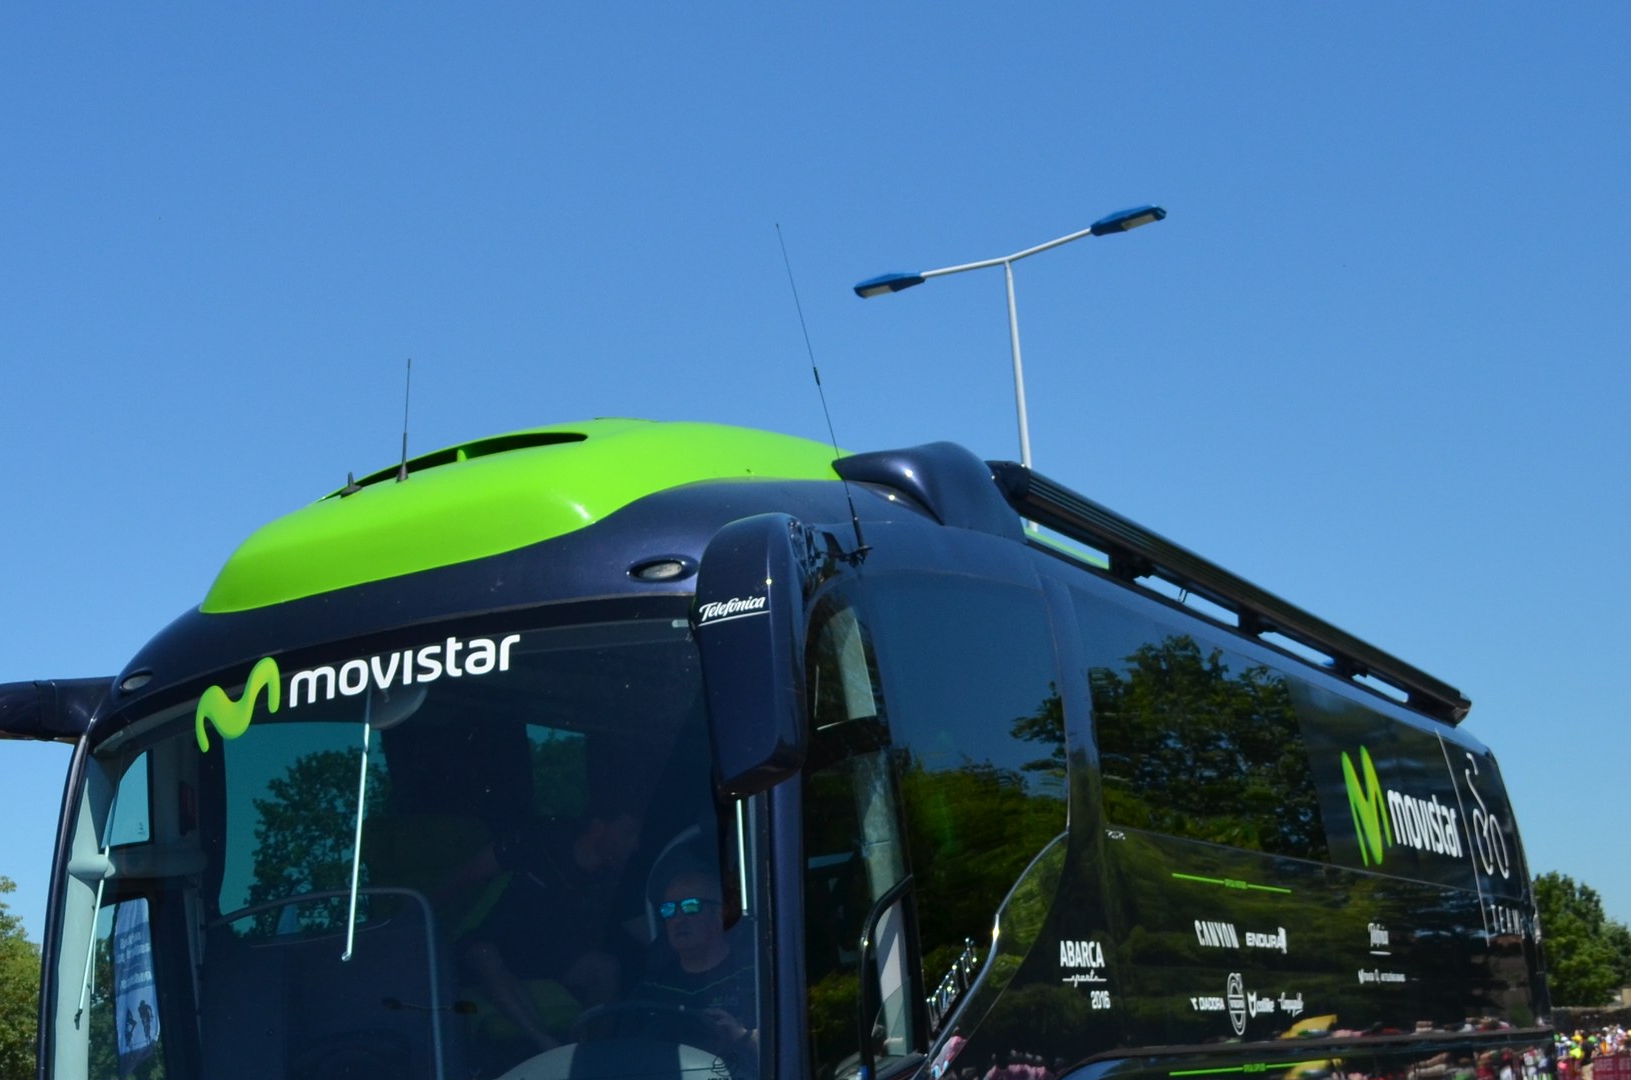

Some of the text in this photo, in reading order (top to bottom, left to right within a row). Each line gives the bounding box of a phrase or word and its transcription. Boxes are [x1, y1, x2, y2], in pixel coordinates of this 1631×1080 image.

[289, 634, 521, 708] movistar
[1387, 789, 1464, 858] movistar
[1194, 919, 1240, 949] CANYON
[1059, 940, 1105, 968] ABARCA
[1090, 990, 1111, 1009] 2016
